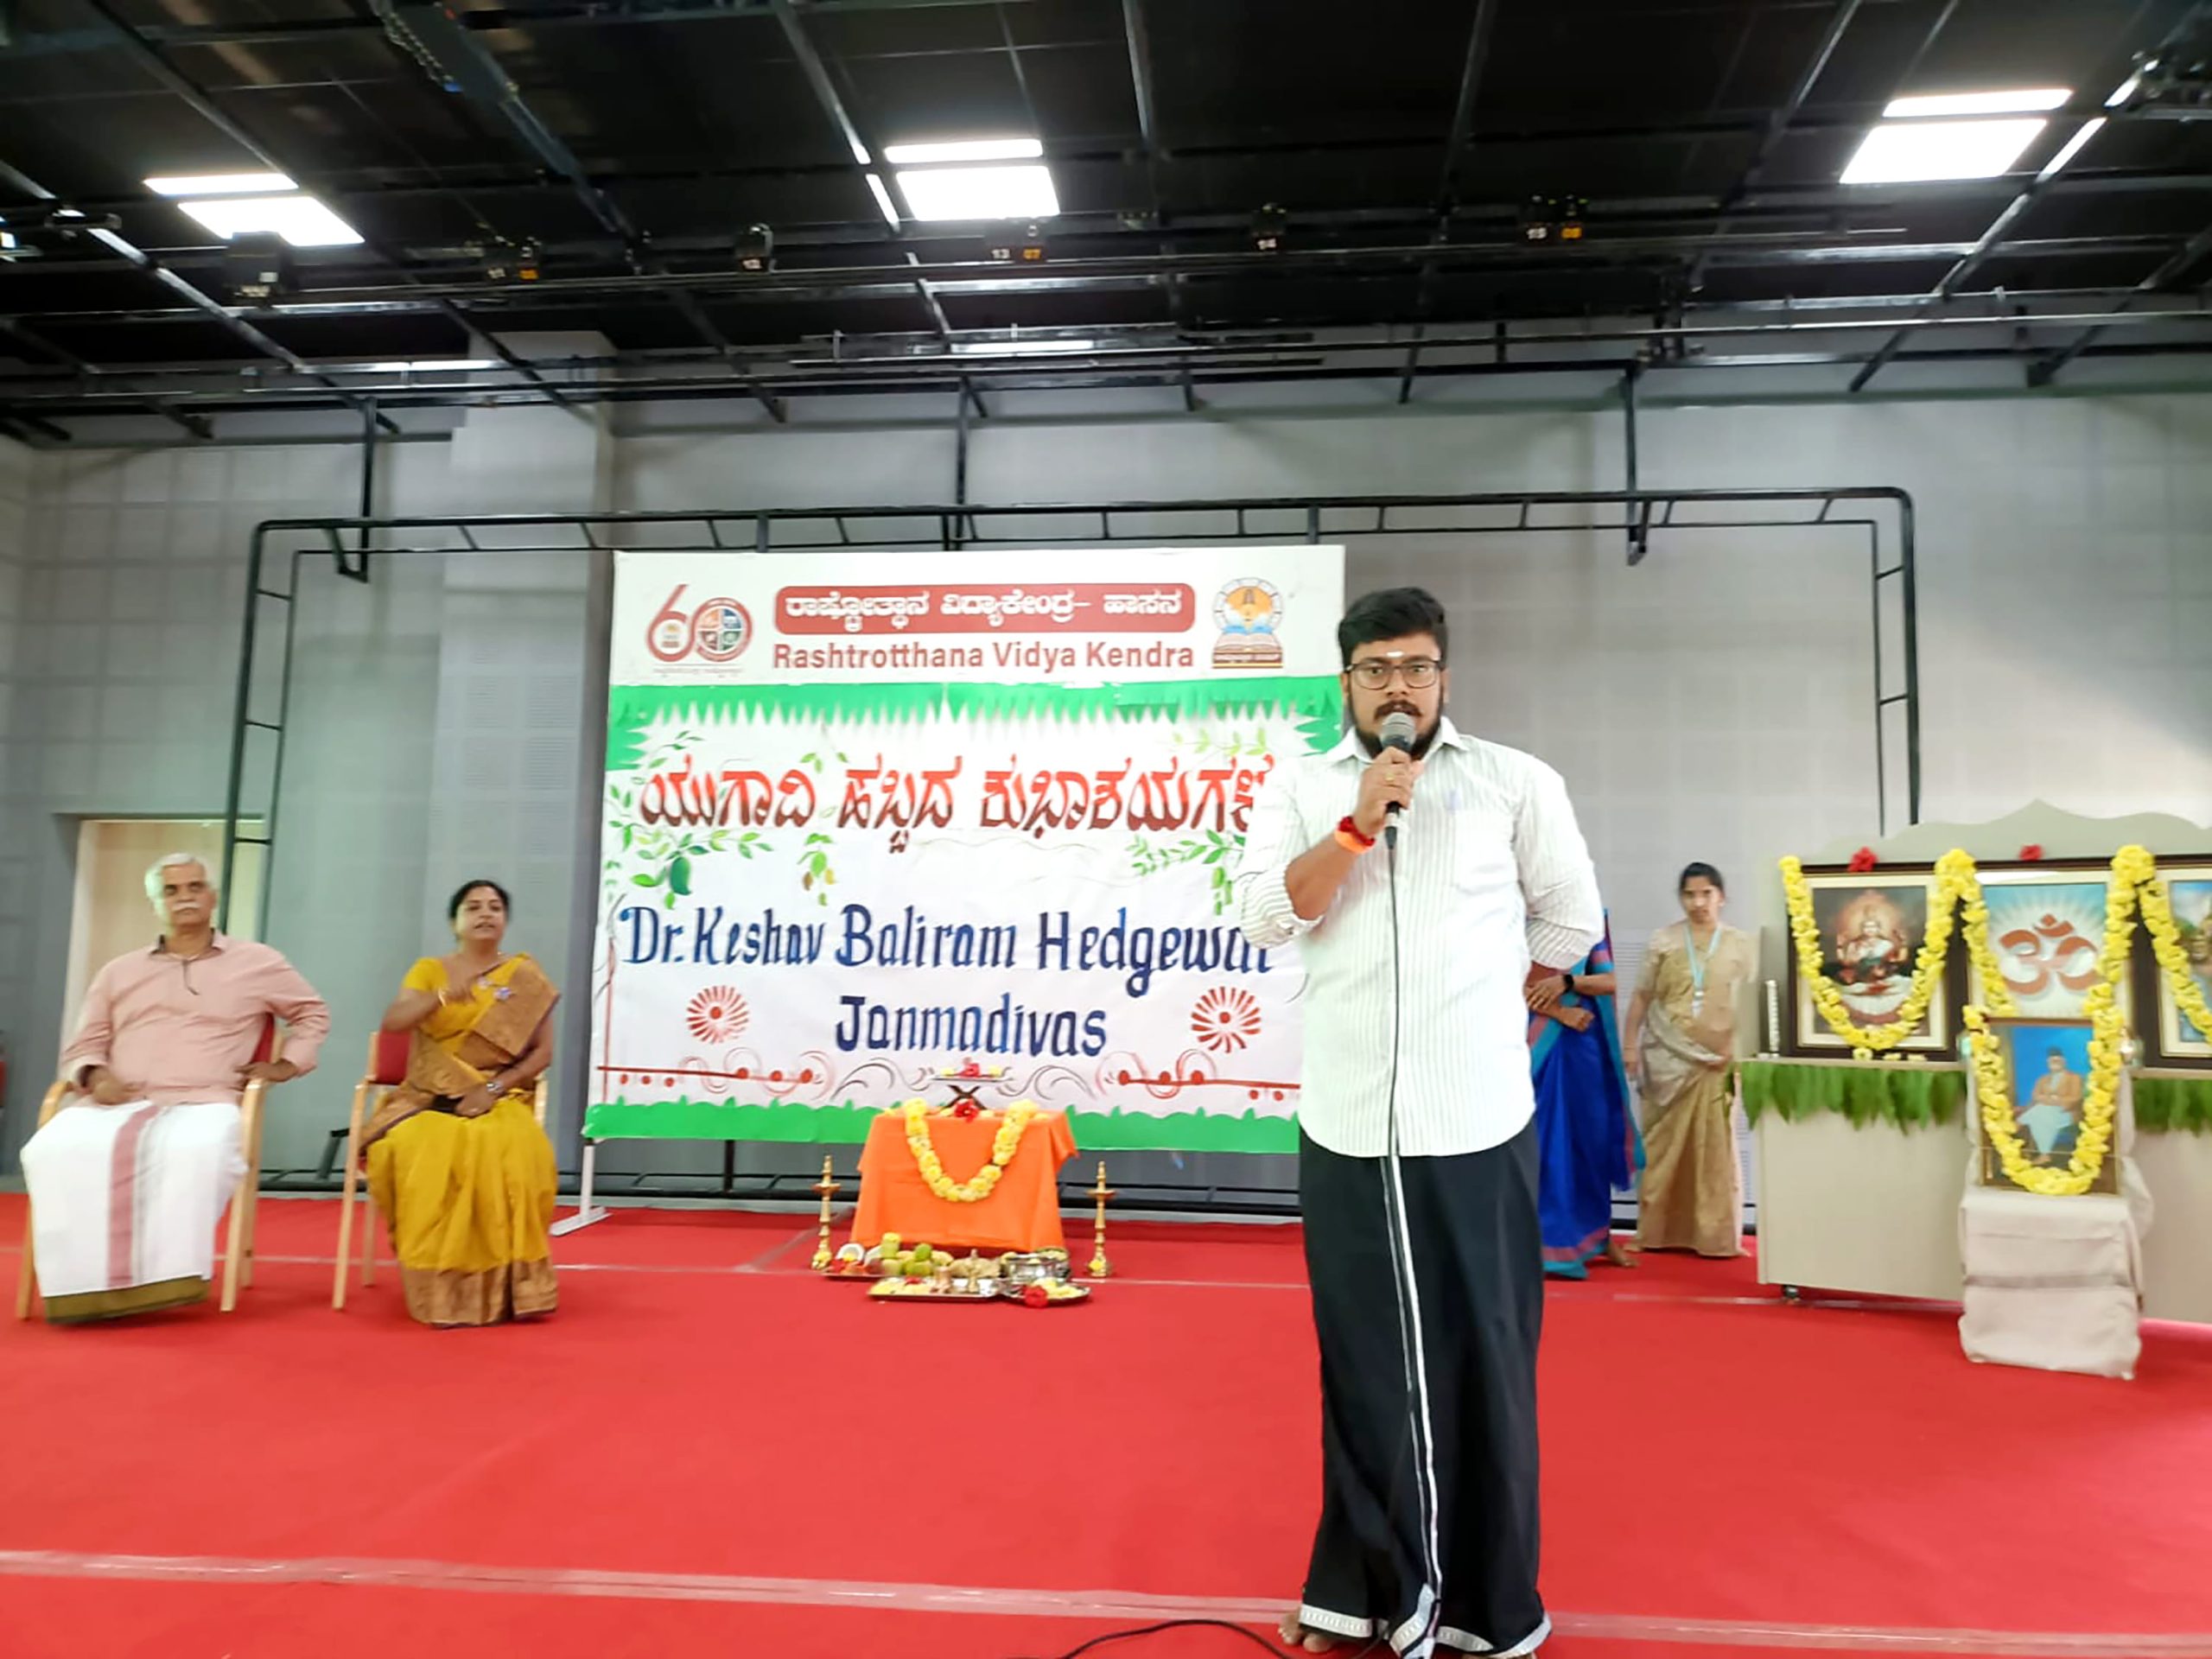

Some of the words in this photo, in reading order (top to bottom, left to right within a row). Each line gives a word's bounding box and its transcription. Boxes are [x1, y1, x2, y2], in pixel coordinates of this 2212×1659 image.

[773, 641, 983, 669] Rashtrotthana
[992, 641, 1075, 674] Vidya
[1086, 641, 1194, 668] Kendra
[835, 903, 1018, 969] Baliram
[836, 993, 1107, 1057] Janmadivas
